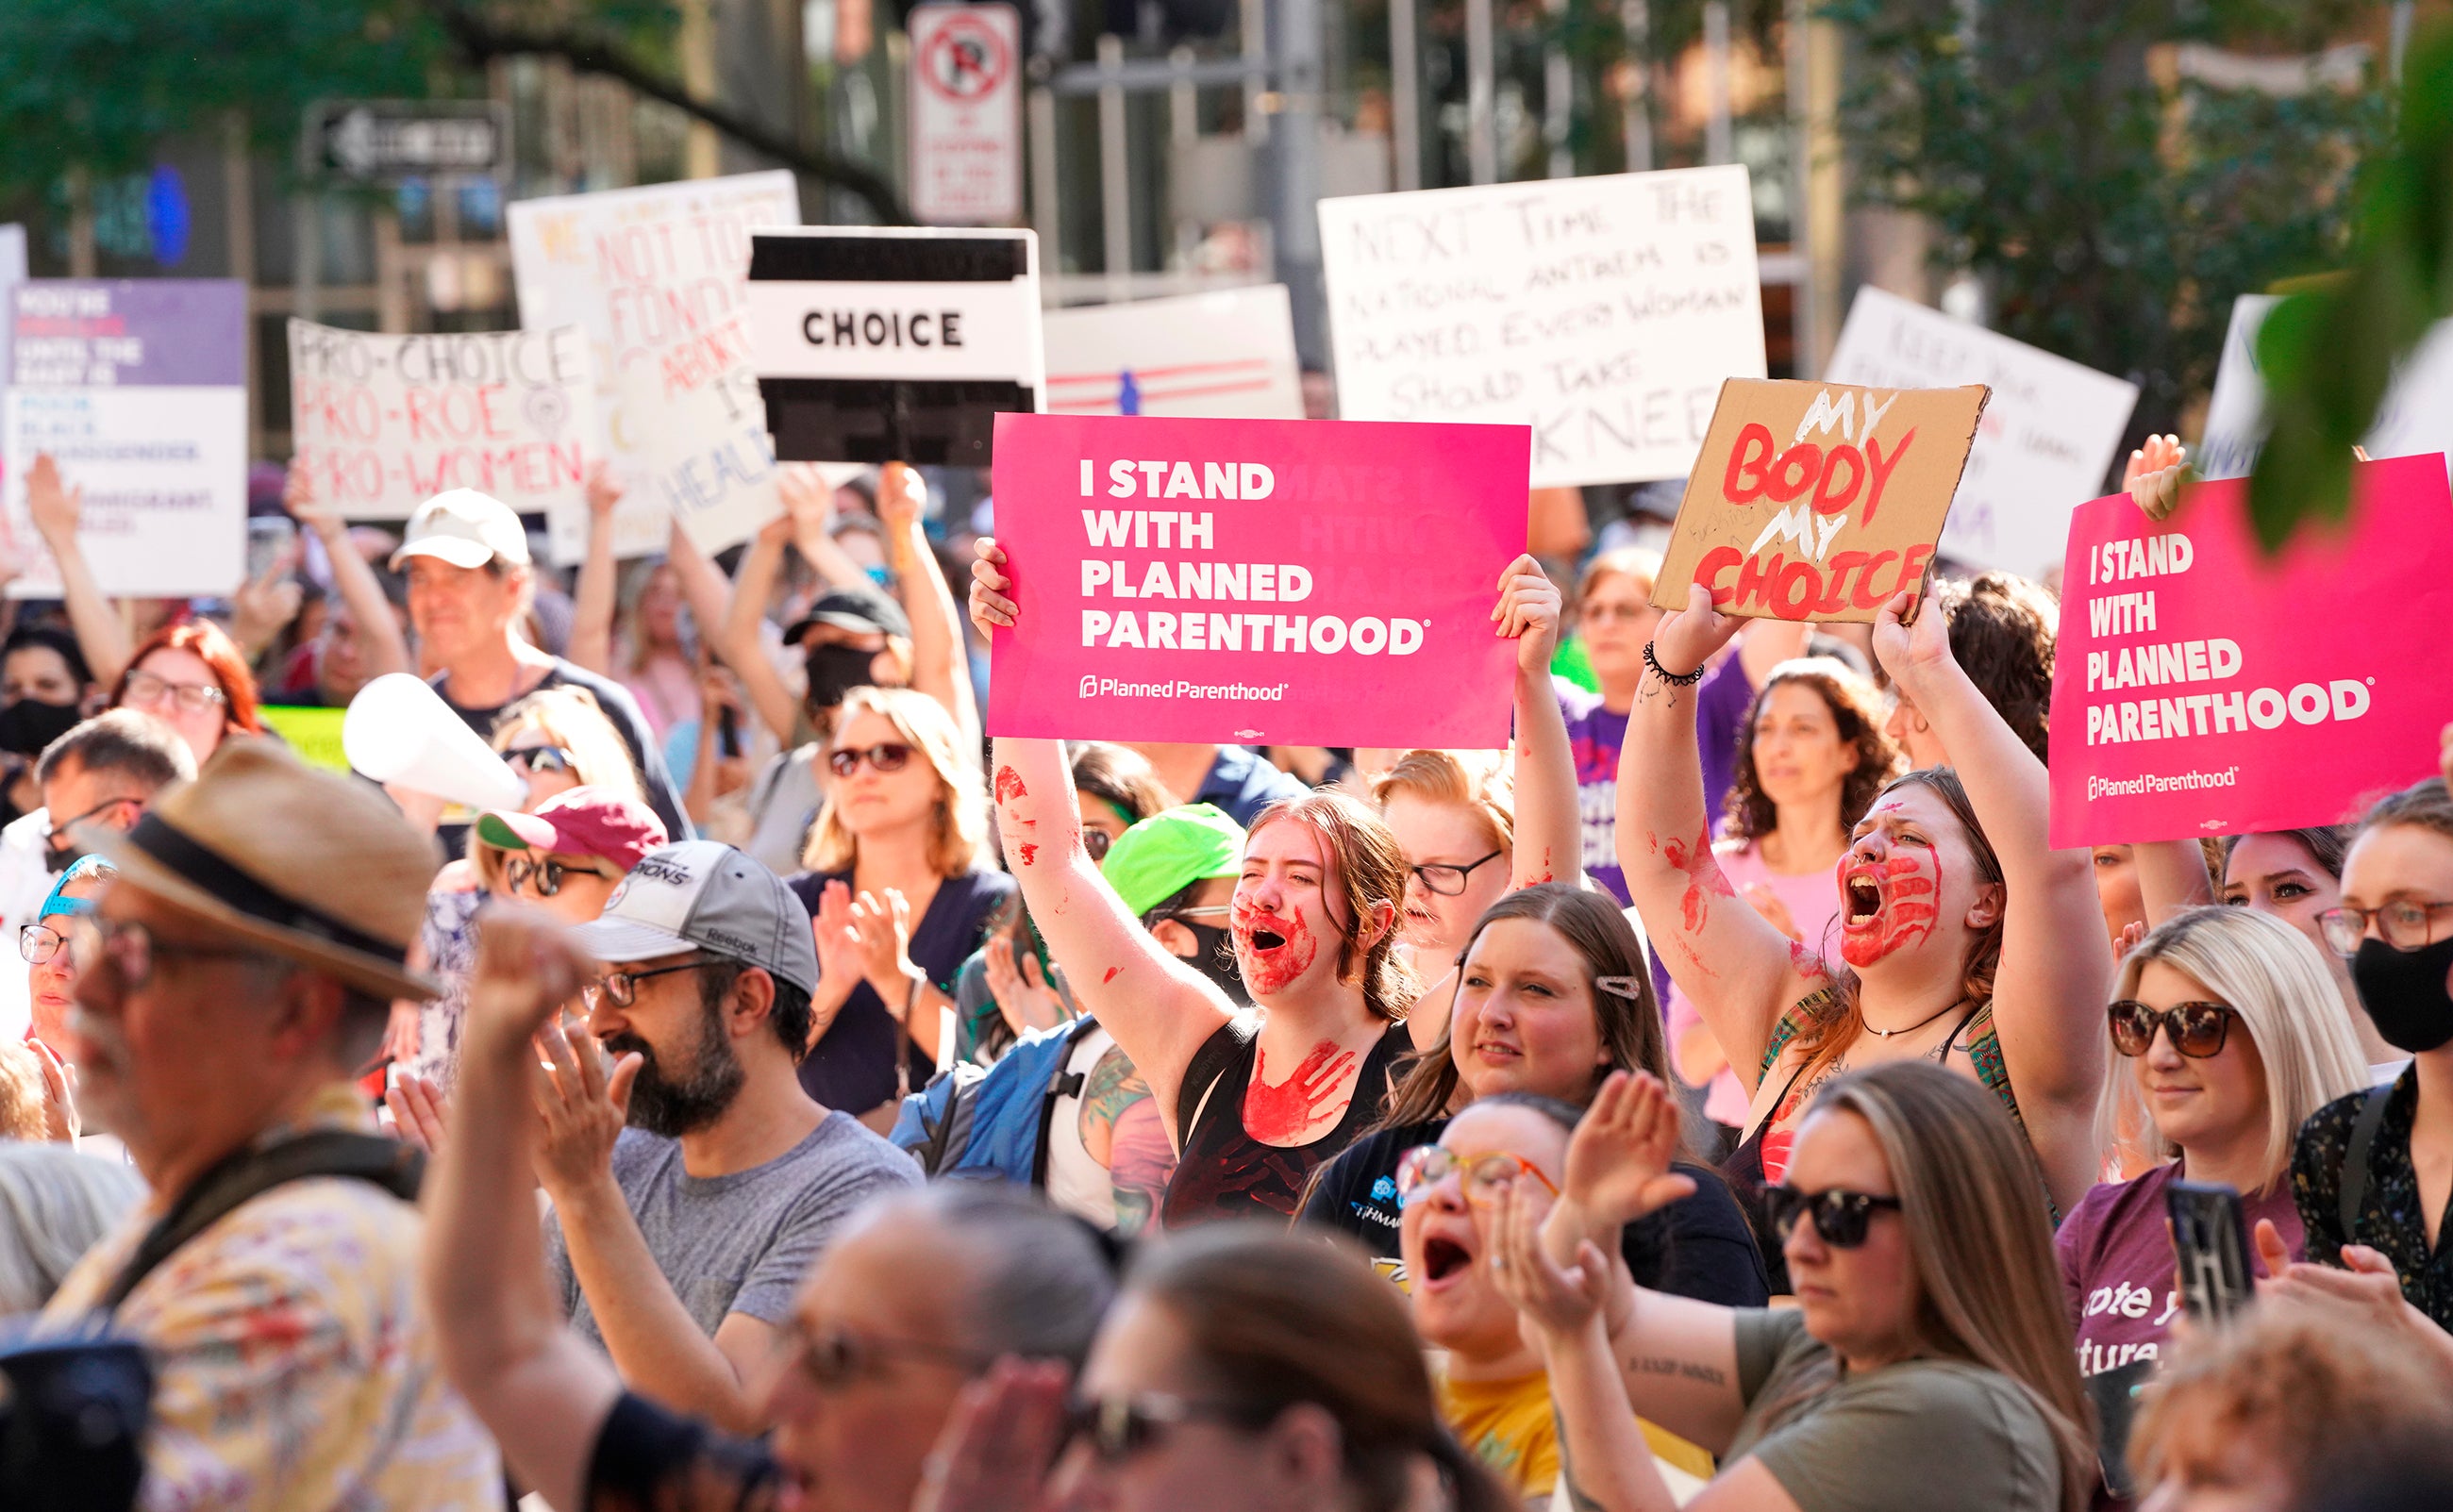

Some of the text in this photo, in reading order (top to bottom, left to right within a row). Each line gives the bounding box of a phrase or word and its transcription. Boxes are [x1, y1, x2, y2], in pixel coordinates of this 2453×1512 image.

[595, 223, 679, 286] NOT
[1350, 201, 1485, 265] NEXT
[298, 324, 581, 385] PRO-CHOICE
[802, 311, 964, 346] CHOICE
[295, 376, 515, 443] PRO-ROE
[1532, 384, 1718, 467] KNEE
[1794, 388, 1900, 451] MY
[1079, 458, 1275, 501] I STAND
[1723, 422, 1919, 530] BODY
[1080, 509, 1214, 550] WITH
[1749, 504, 1848, 563] MY
[1081, 559, 1313, 603] PLANNED
[1694, 542, 1935, 621] CHOICE
[2089, 533, 2194, 586] I STAND
[2089, 590, 2157, 639] WITH
[1100, 678, 1174, 698] Planned
[2087, 638, 2243, 692] PLANNED
[2097, 773, 2145, 798] Planned
[626, 862, 691, 887] PIONS
[707, 927, 759, 955] Reebok
